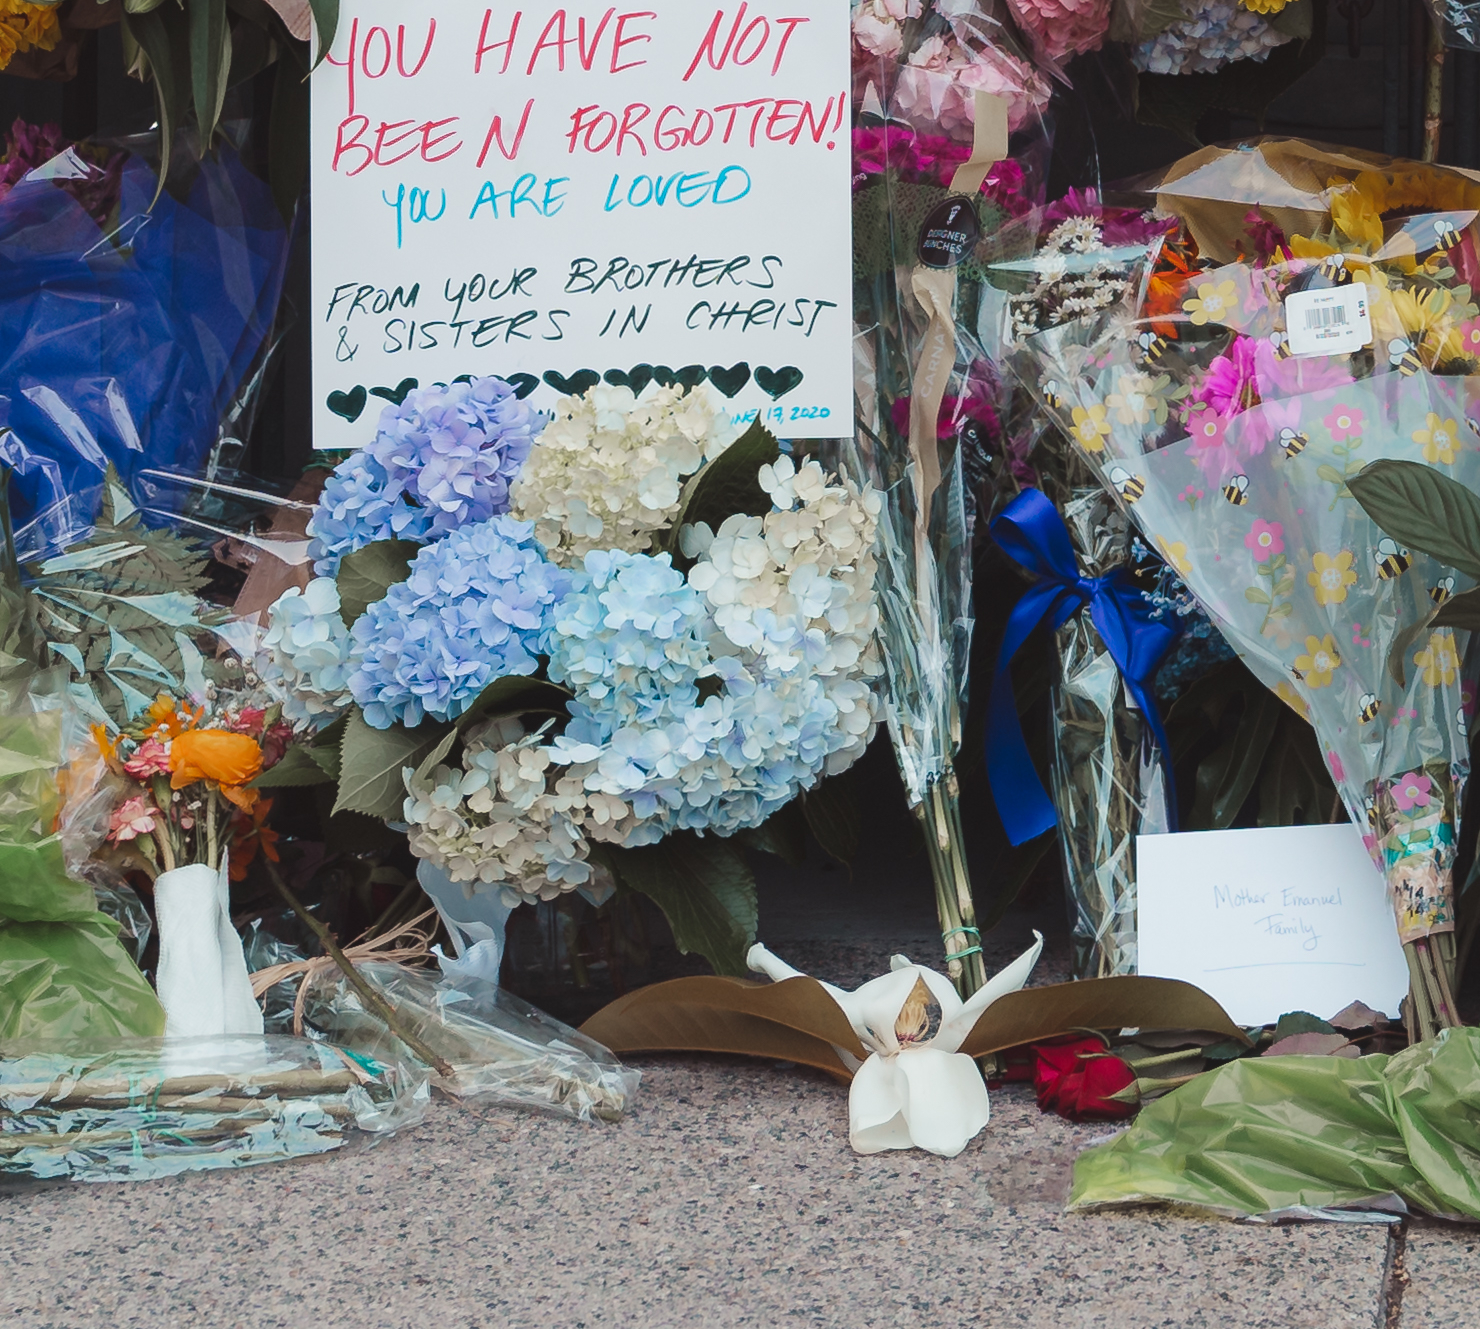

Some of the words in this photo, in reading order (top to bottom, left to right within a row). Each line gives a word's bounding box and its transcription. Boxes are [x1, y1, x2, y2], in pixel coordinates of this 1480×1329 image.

[325, 16, 437, 115] YOU
[474, 7, 657, 76] HAVE
[681, 0, 810, 81] NOT
[565, 90, 847, 159] FORGOTTEN!
[381, 180, 446, 249] YOU
[468, 172, 572, 220] ARE
[603, 163, 752, 212] LOVED
[324, 282, 420, 323] FROM
[443, 266, 538, 315] YOUR
[564, 252, 784, 295] BROTHERS
[335, 325, 359, 363] &
[382, 308, 572, 355] SISTERS
[599, 302, 653, 338] IN
[685, 298, 839, 338] CHRIST
[767, 406, 784, 425] 17,
[789, 405, 831, 421] 2020
[1213, 884, 1270, 909] Mother
[1281, 886, 1344, 908] Emanuel
[1253, 913, 1323, 952] Family
